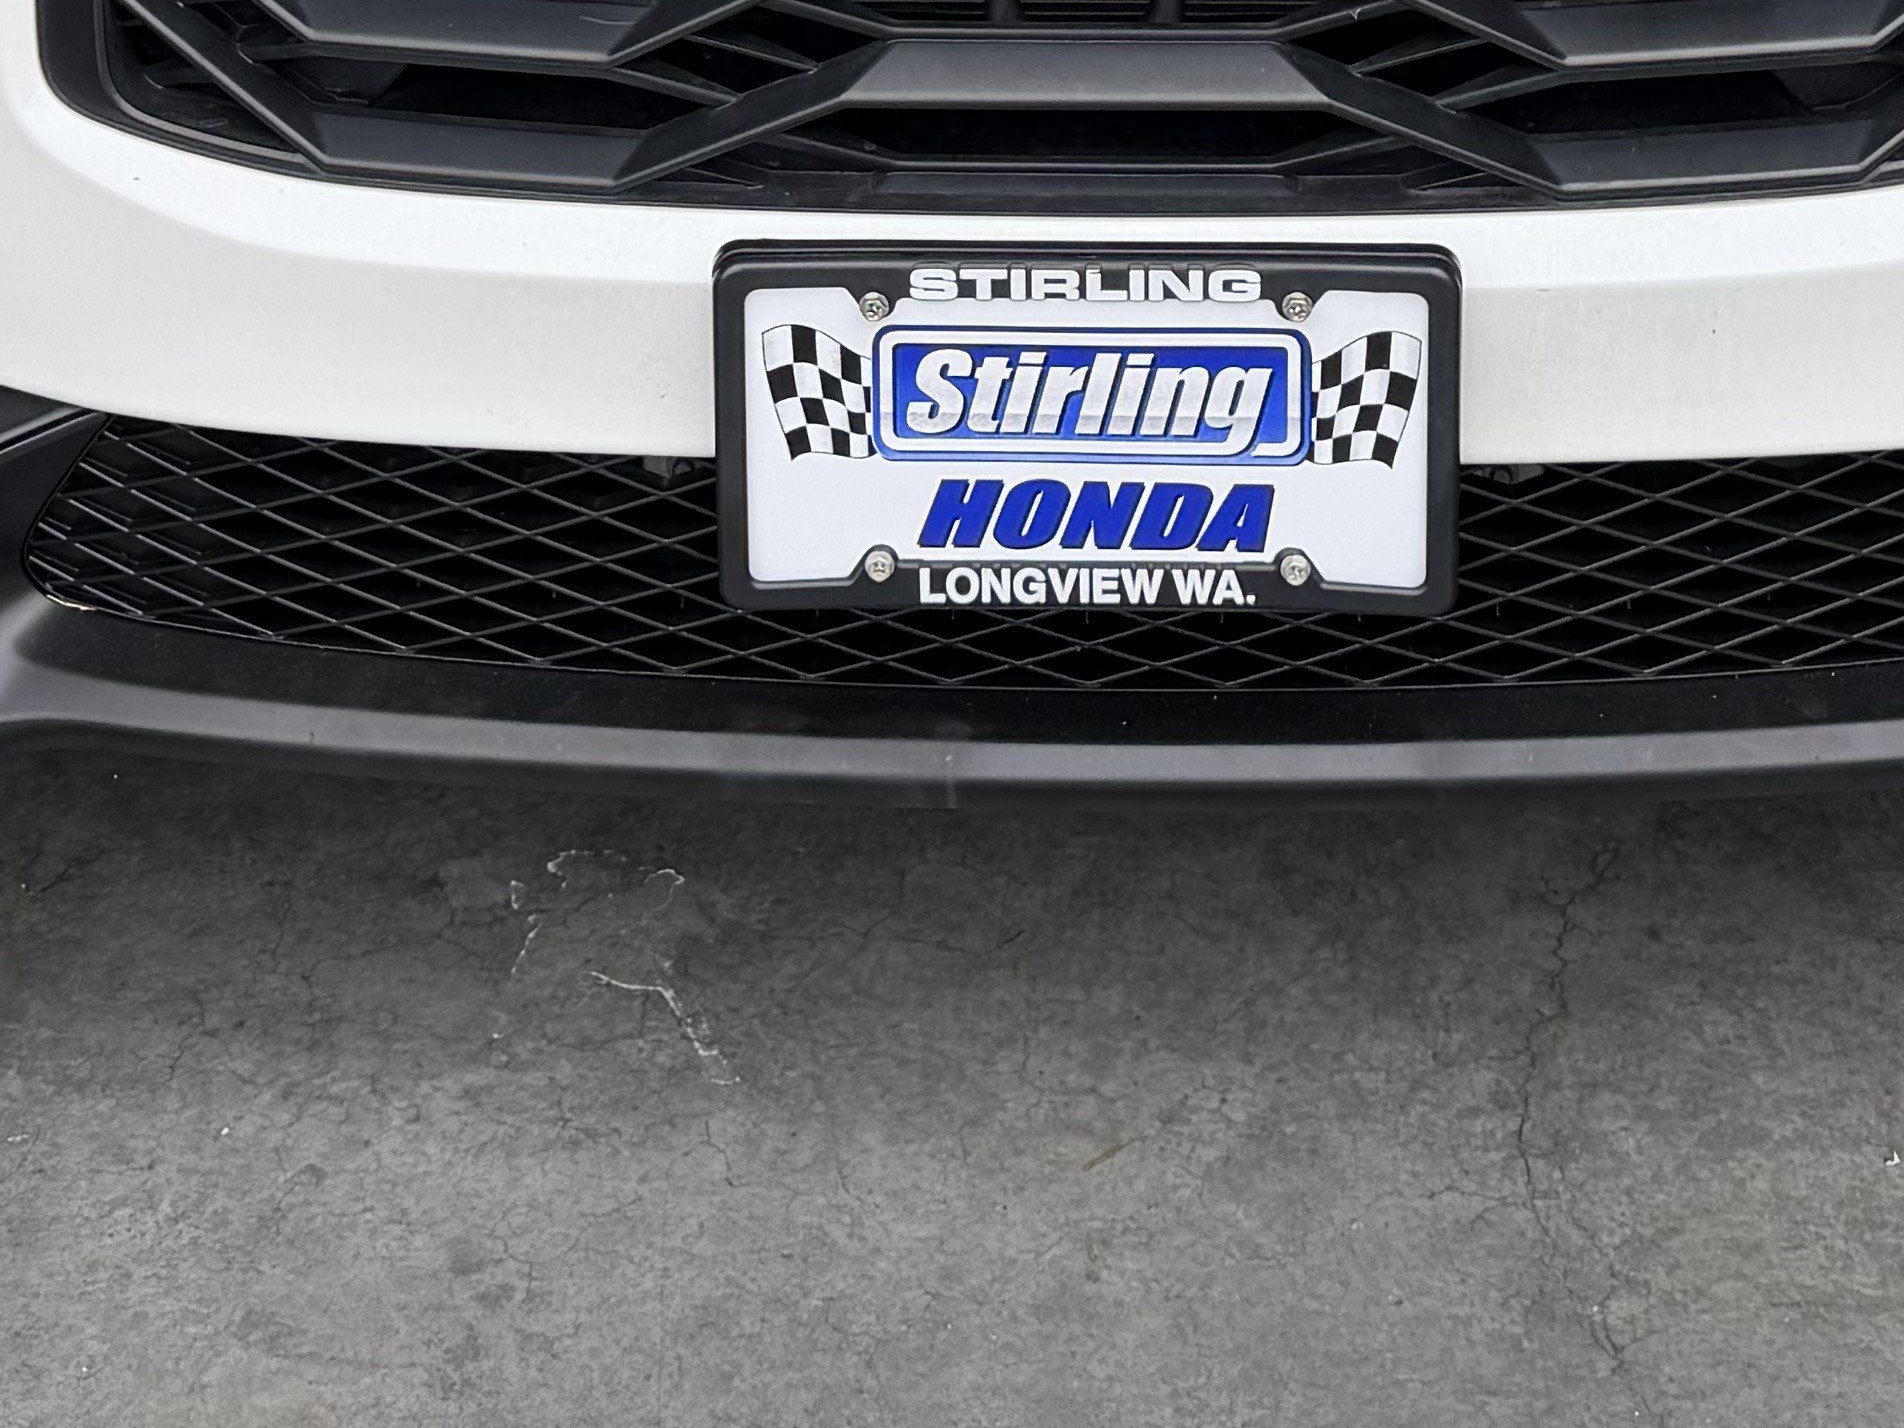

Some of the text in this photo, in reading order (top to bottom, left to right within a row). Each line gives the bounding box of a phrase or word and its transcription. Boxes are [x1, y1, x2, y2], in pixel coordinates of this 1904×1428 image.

[908, 267, 1263, 304] STIRLING
[904, 348, 1273, 452] Stirling
[917, 478, 1276, 553] HONDA
[919, 566, 1256, 605] LONGVIEW WA.
